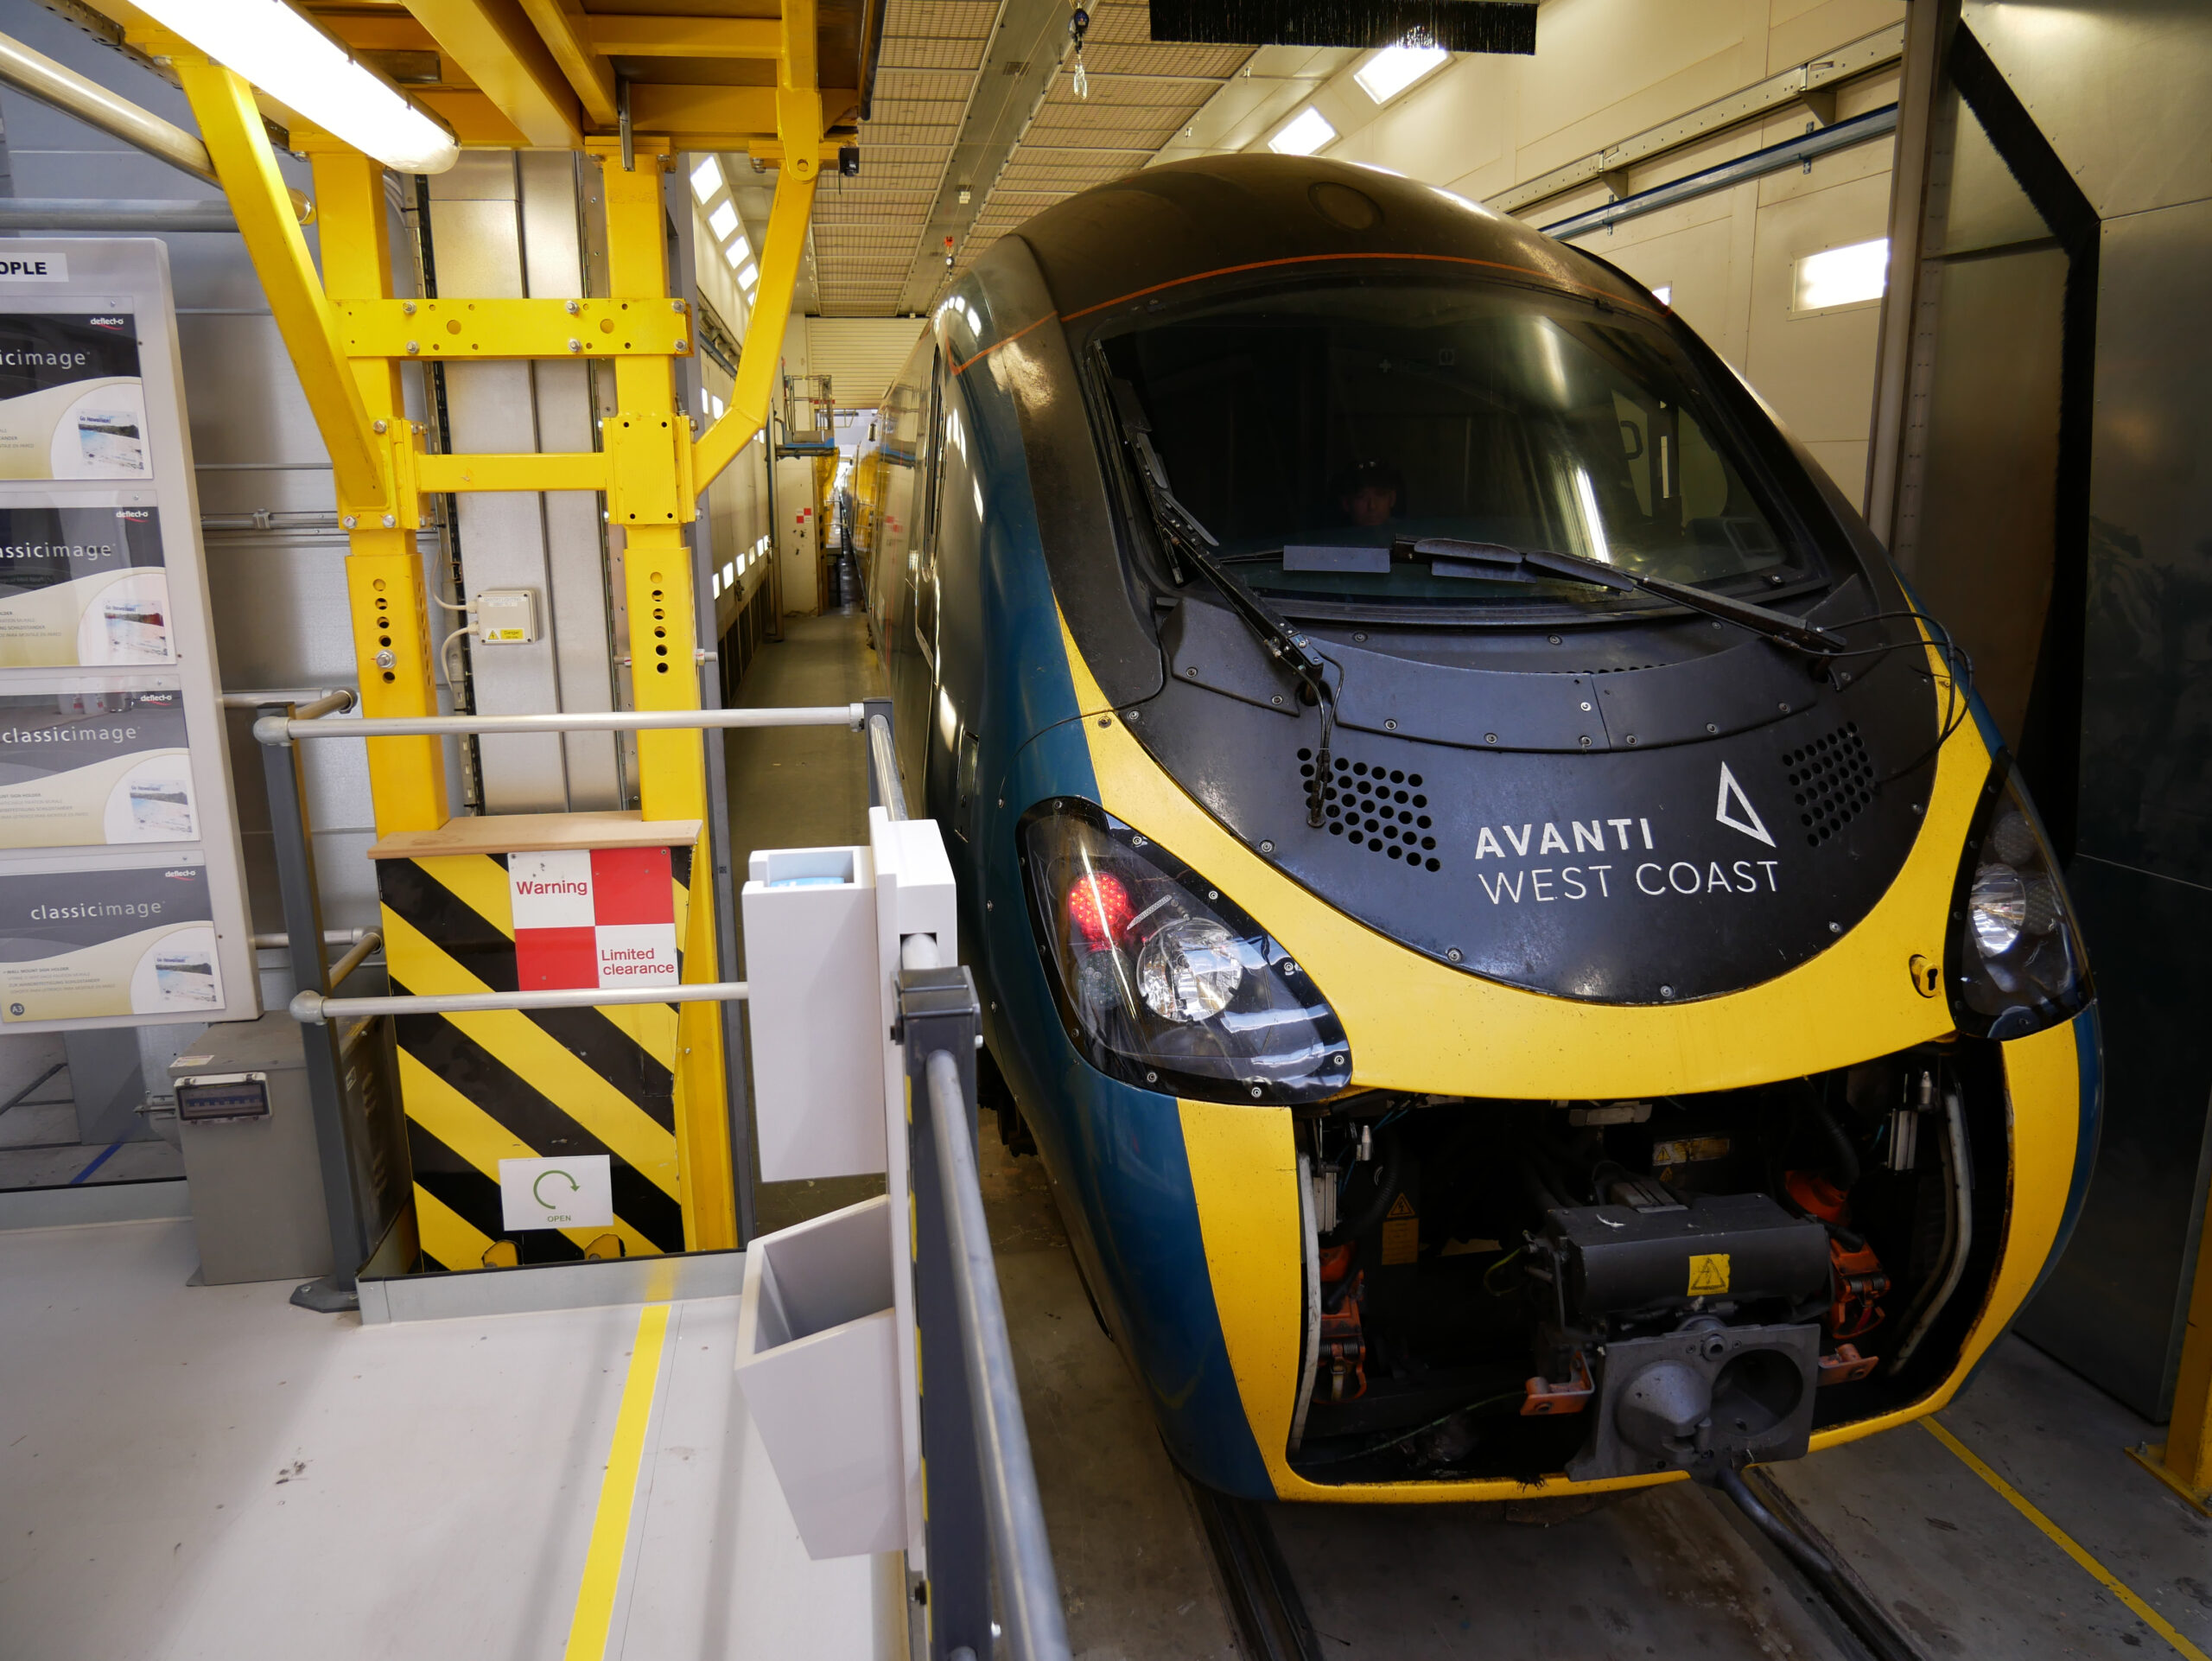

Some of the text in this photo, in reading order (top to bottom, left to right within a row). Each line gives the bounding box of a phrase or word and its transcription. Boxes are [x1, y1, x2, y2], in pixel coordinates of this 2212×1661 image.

[2, 726, 137, 744] classicimage
[1475, 818, 1654, 860] AVANTI
[517, 880, 588, 895] Warning
[1478, 861, 1778, 905] WEST COAST
[31, 901, 162, 920] classicimage
[601, 948, 654, 961] Limited
[603, 963, 674, 975] clearance
